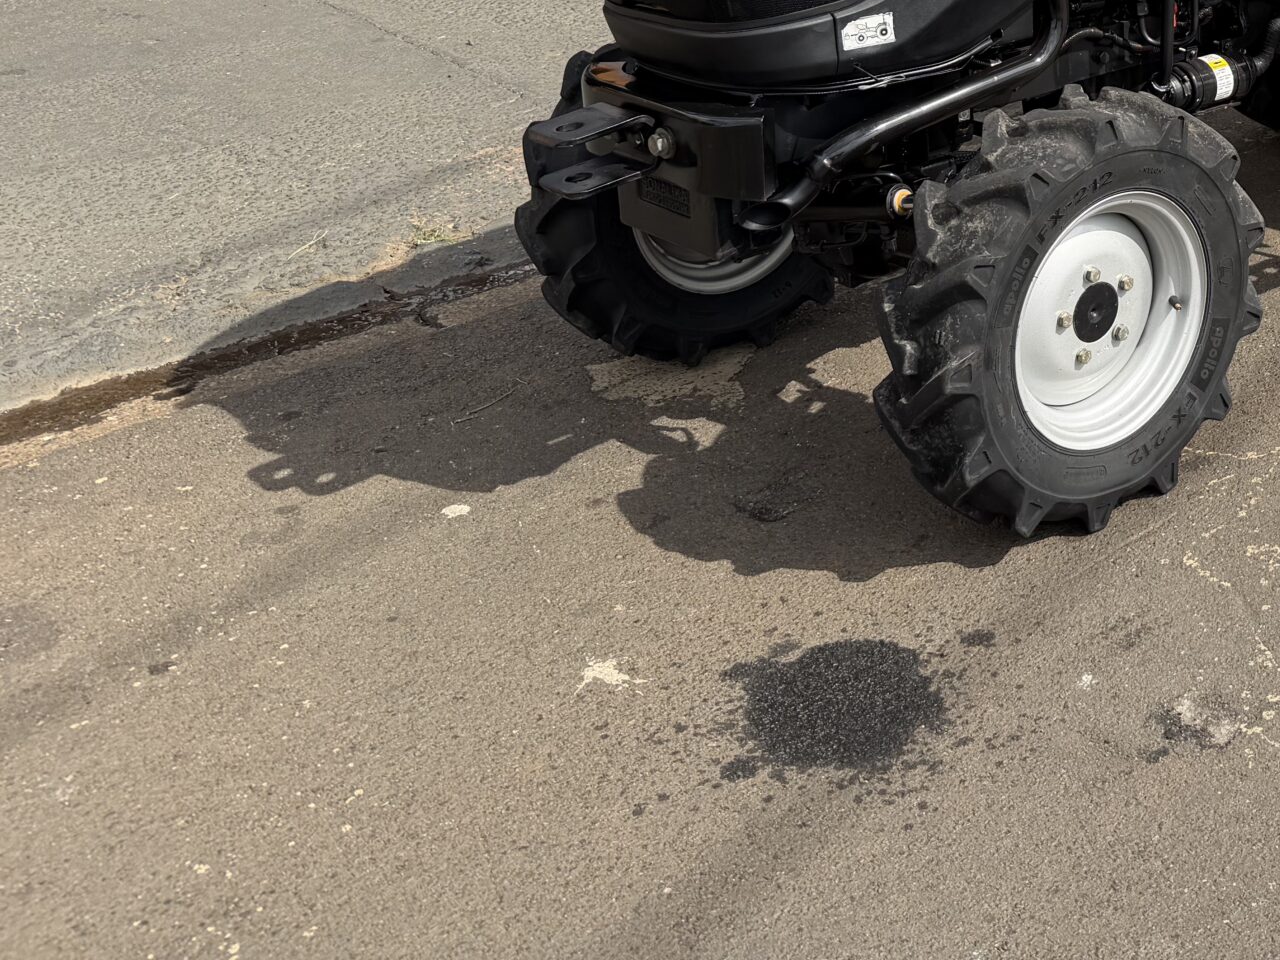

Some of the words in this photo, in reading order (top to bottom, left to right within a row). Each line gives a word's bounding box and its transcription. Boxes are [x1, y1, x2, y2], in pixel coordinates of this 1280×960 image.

[1036, 171, 1113, 244] FX-212
[1003, 257, 1031, 315] apollo
[1200, 325, 1225, 380] apollo
[1127, 392, 1198, 466] FX-212
